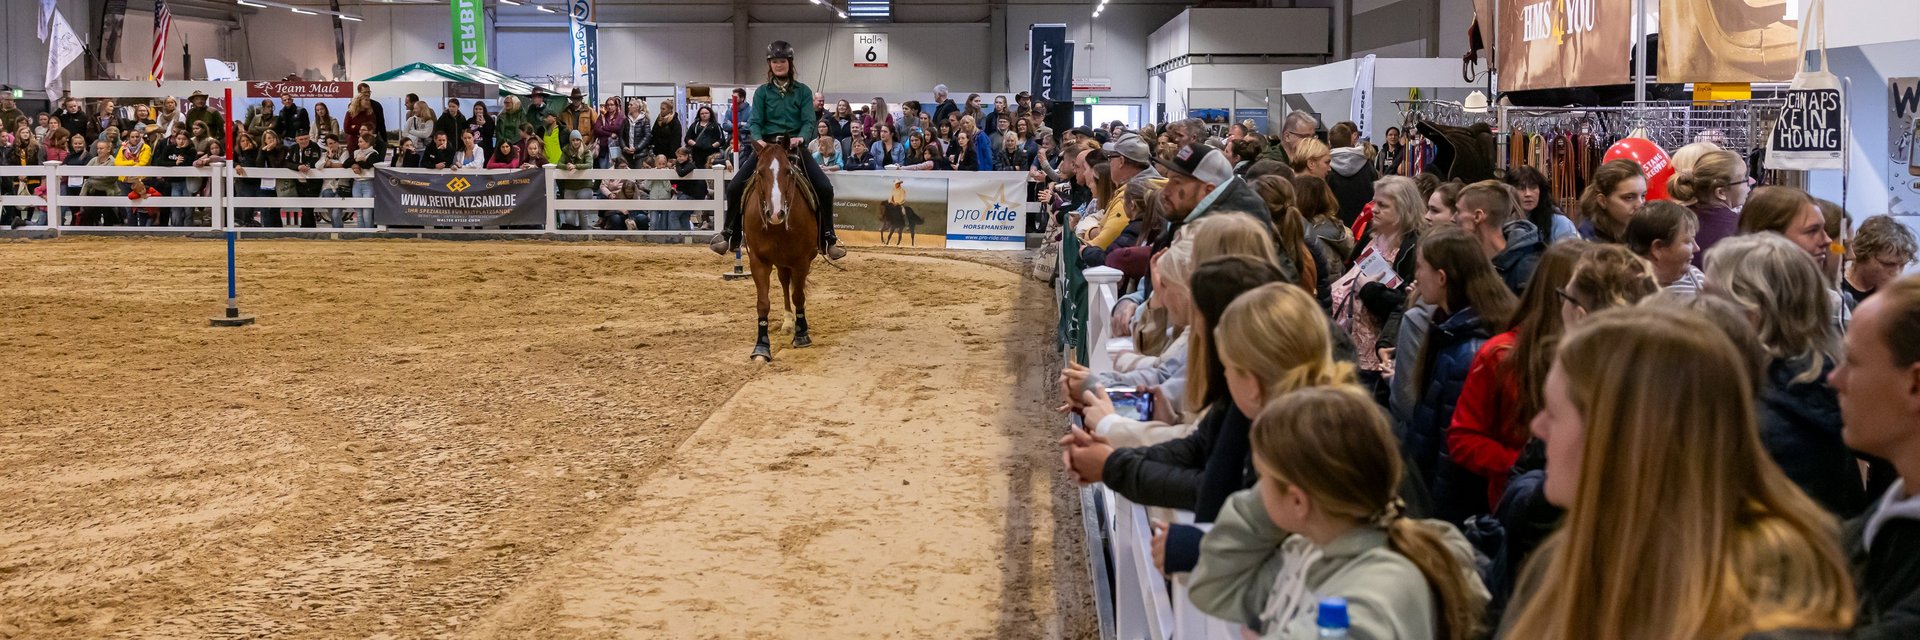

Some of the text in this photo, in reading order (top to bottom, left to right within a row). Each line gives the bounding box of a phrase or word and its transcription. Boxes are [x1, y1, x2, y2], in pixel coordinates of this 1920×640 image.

[1523, 2, 1551, 42] HMS
[1566, 0, 1595, 34] YOU
[866, 46, 877, 62] 6
[1042, 44, 1053, 100] ARIAT
[275, 82, 339, 93] Team Mala
[1781, 92, 1838, 111] SCHNAPS
[1778, 108, 1827, 130] KEIN
[1781, 128, 1837, 148] HONIG
[401, 194, 516, 208] WWW.REITPLATZSAND.DE
[954, 206, 1017, 222] pro ride
